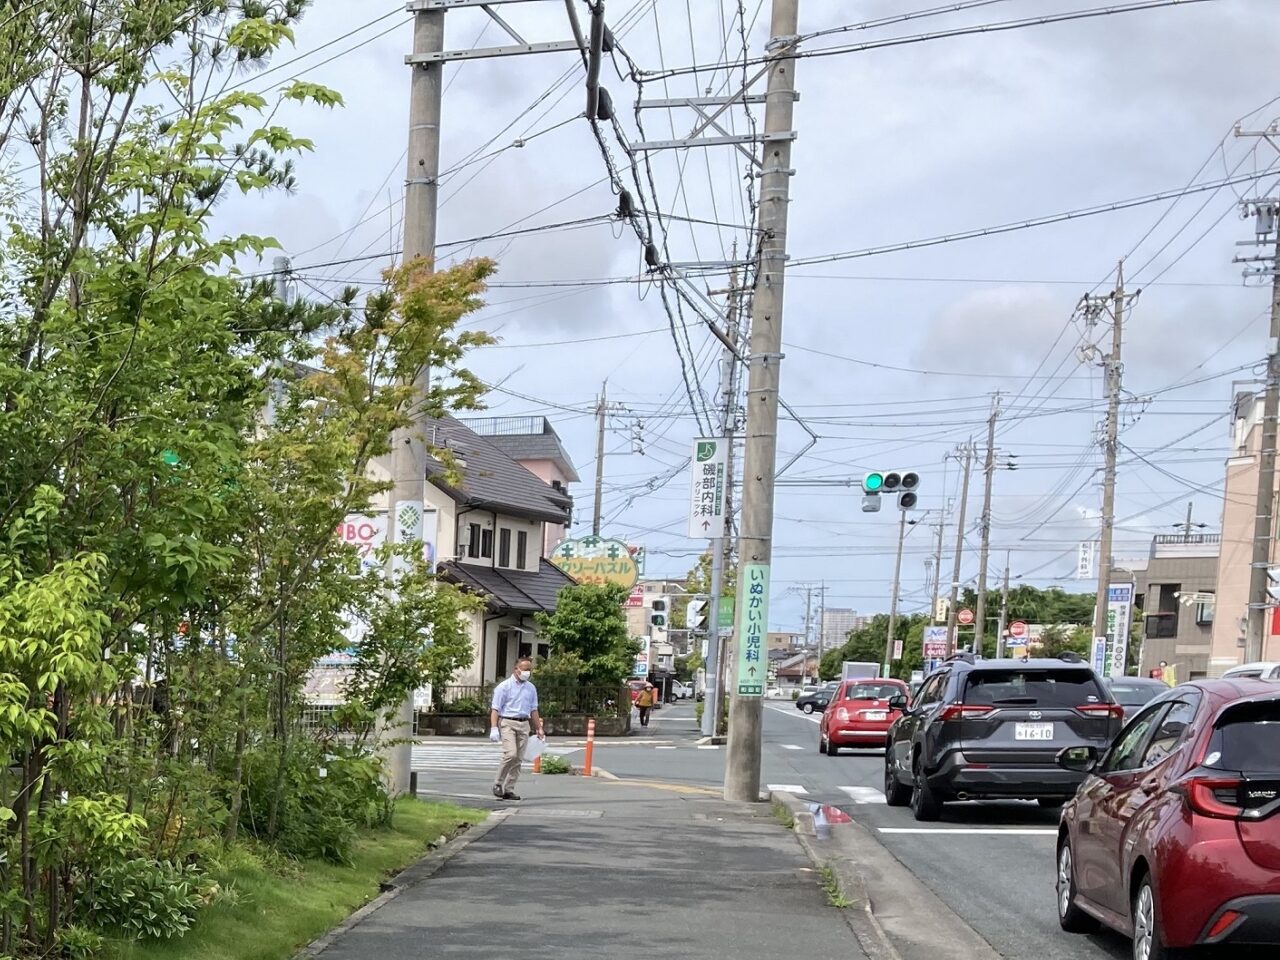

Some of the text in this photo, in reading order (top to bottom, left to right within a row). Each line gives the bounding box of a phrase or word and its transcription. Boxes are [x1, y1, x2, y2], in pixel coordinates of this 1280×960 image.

[693, 481, 701, 517] クリニック
[700, 463, 716, 516] 磯部内科
[745, 569, 764, 662] いぬかい小児科
